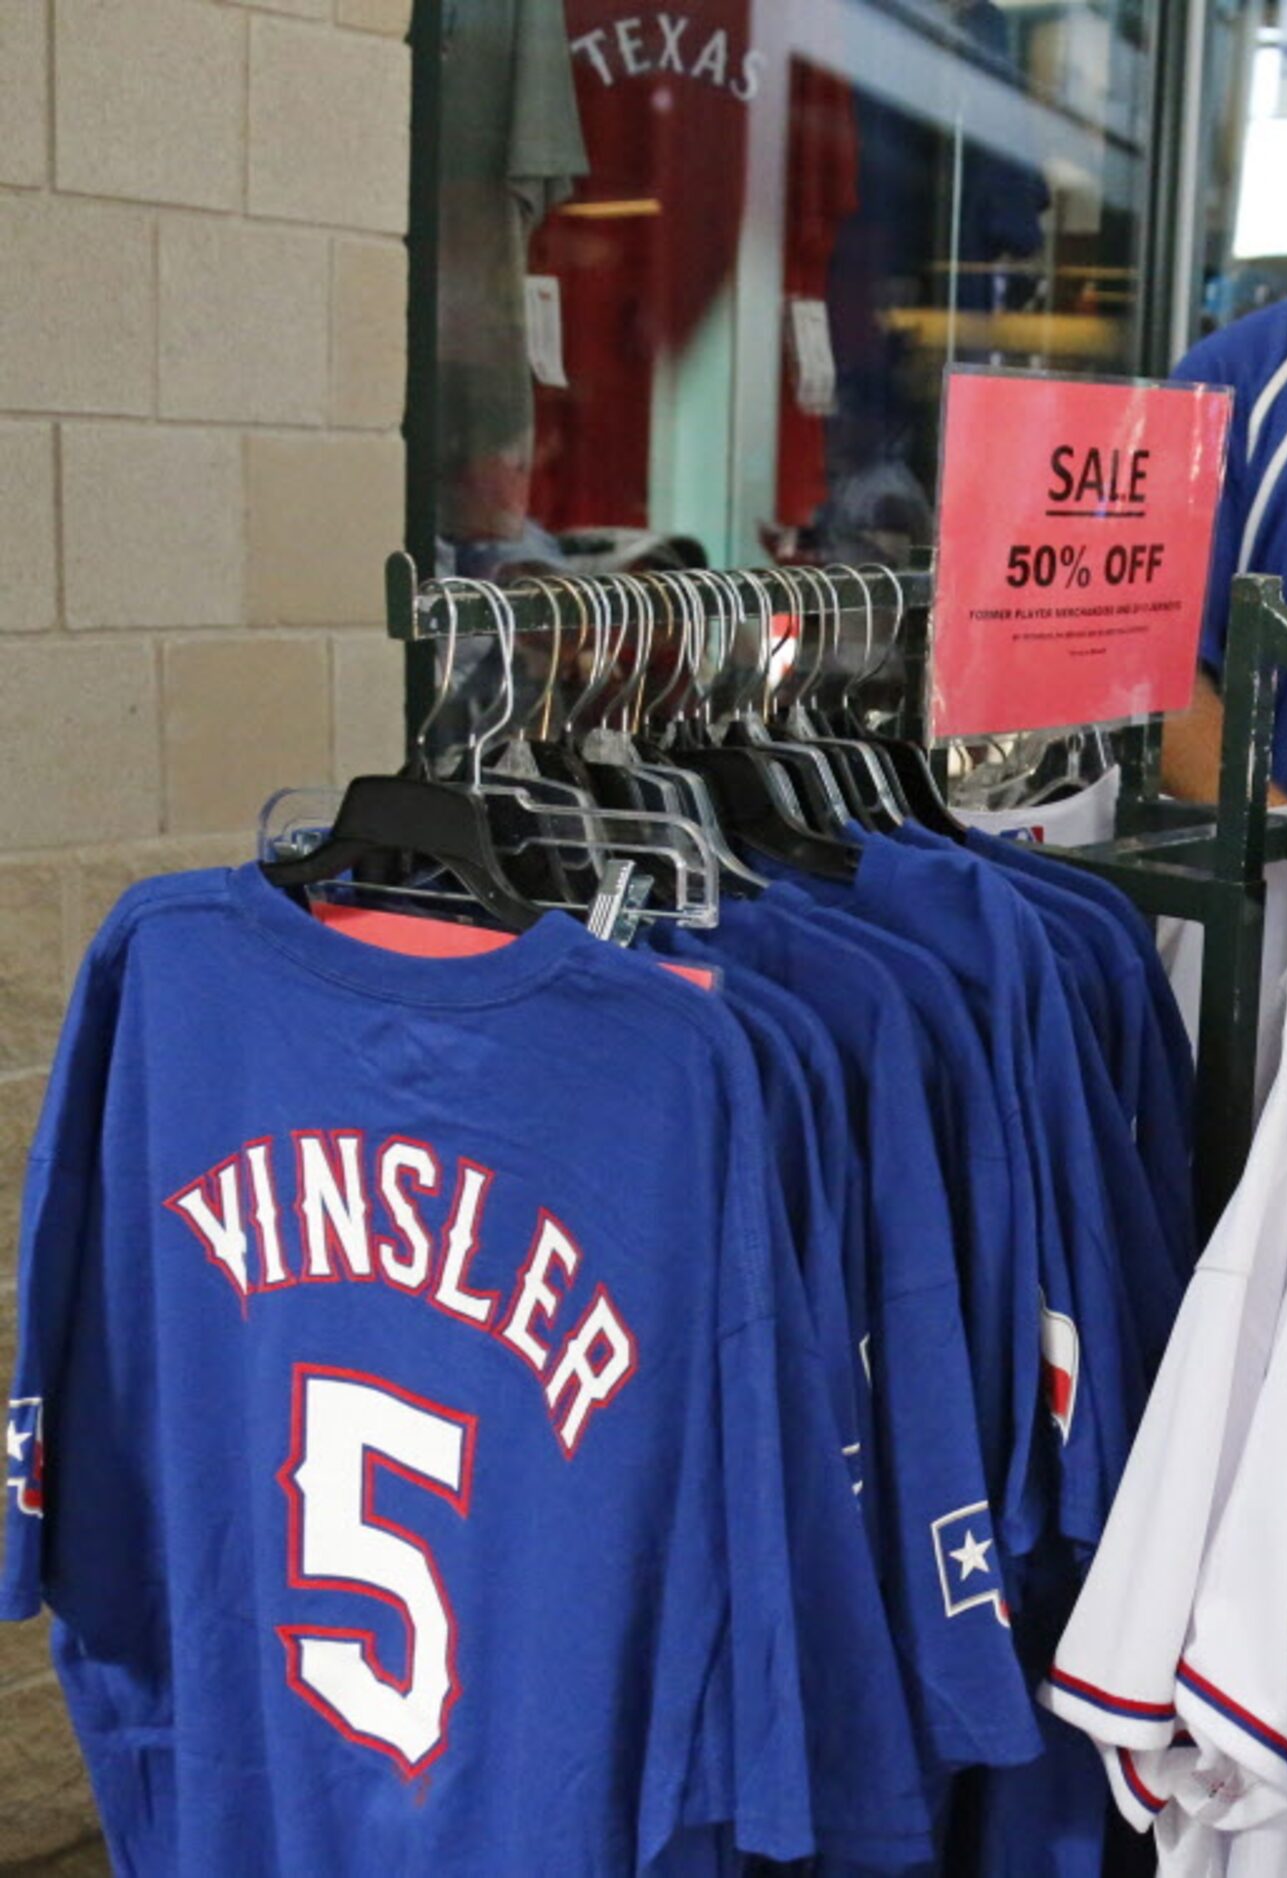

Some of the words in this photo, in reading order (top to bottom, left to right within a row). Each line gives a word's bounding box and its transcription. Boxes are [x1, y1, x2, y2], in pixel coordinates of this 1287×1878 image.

[570, 13, 769, 101] TEXAS
[1048, 445, 1150, 502] SALE
[1006, 545, 1091, 589] 50%
[1104, 544, 1165, 585] OFF
[274, 1362, 478, 1778] 5
